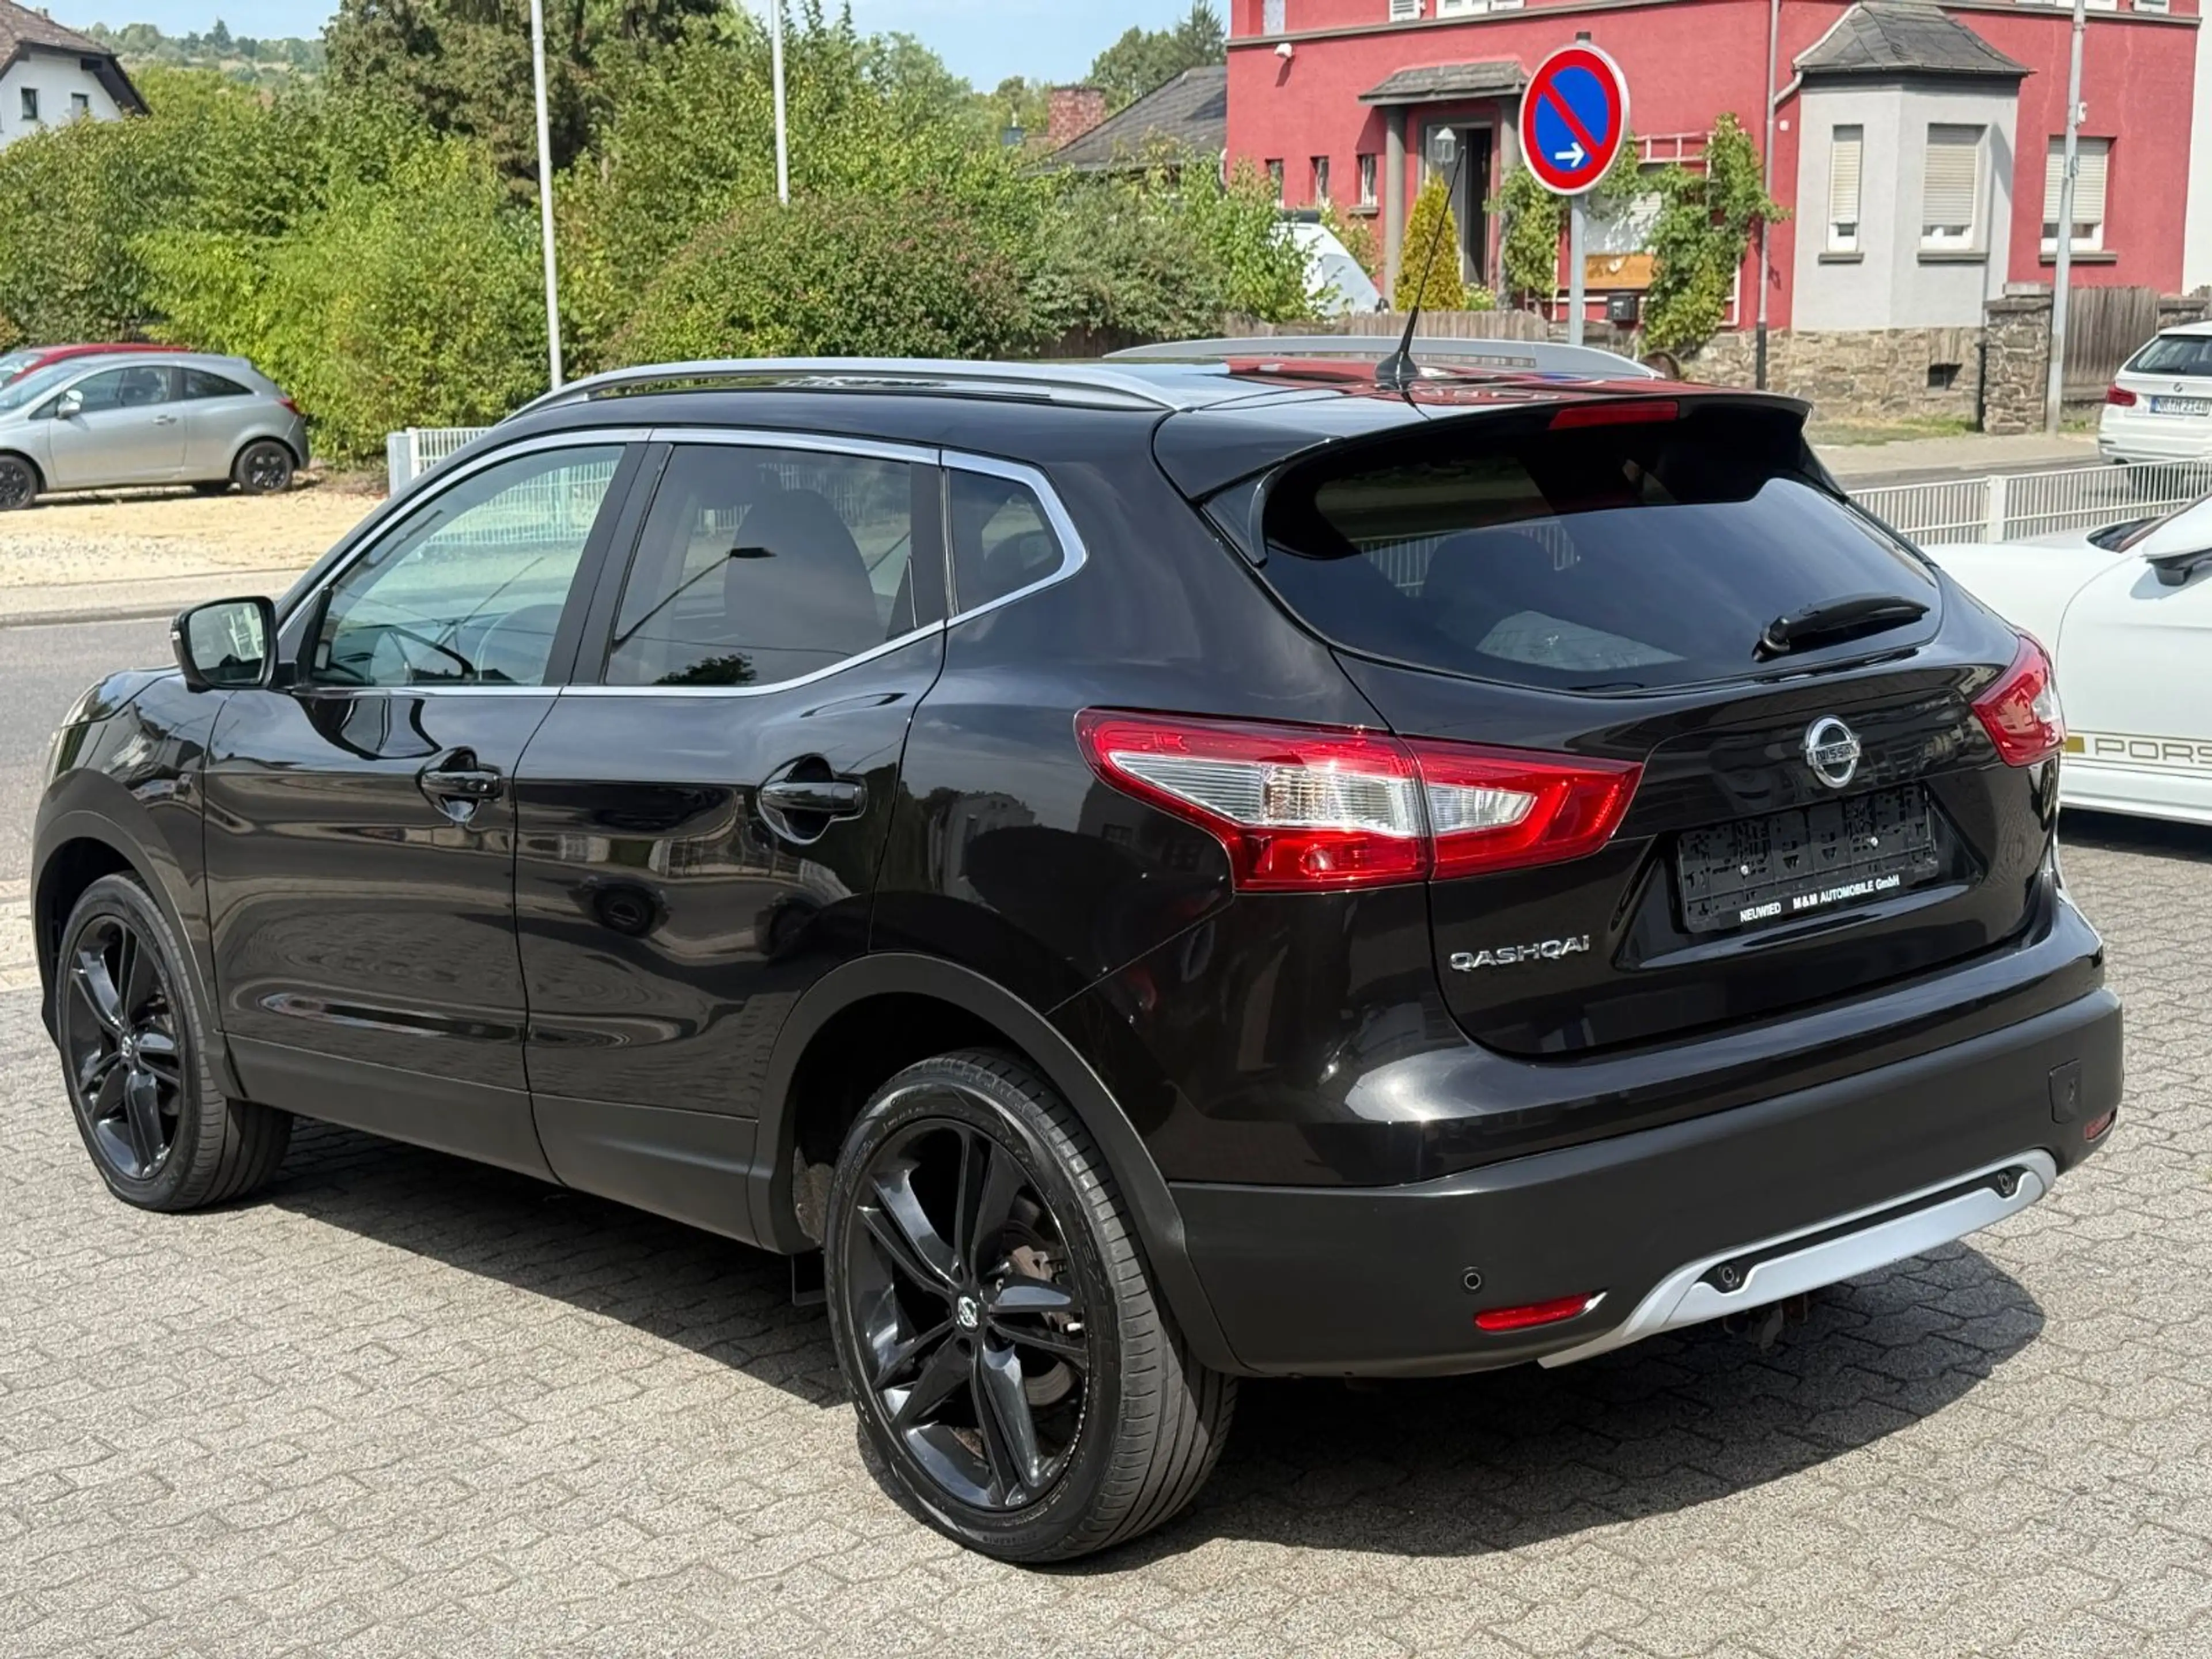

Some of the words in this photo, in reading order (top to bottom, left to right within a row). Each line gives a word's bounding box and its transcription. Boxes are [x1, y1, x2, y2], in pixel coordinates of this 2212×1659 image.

[1815, 745, 1855, 761] NISSA
[1740, 902, 1781, 922] NEUWIED
[1793, 894, 1817, 910] M&M
[1820, 880, 1874, 903] AUTOMOBILE
[1876, 874, 1900, 891] GmbH
[1449, 934, 1590, 972] QASHQAI
